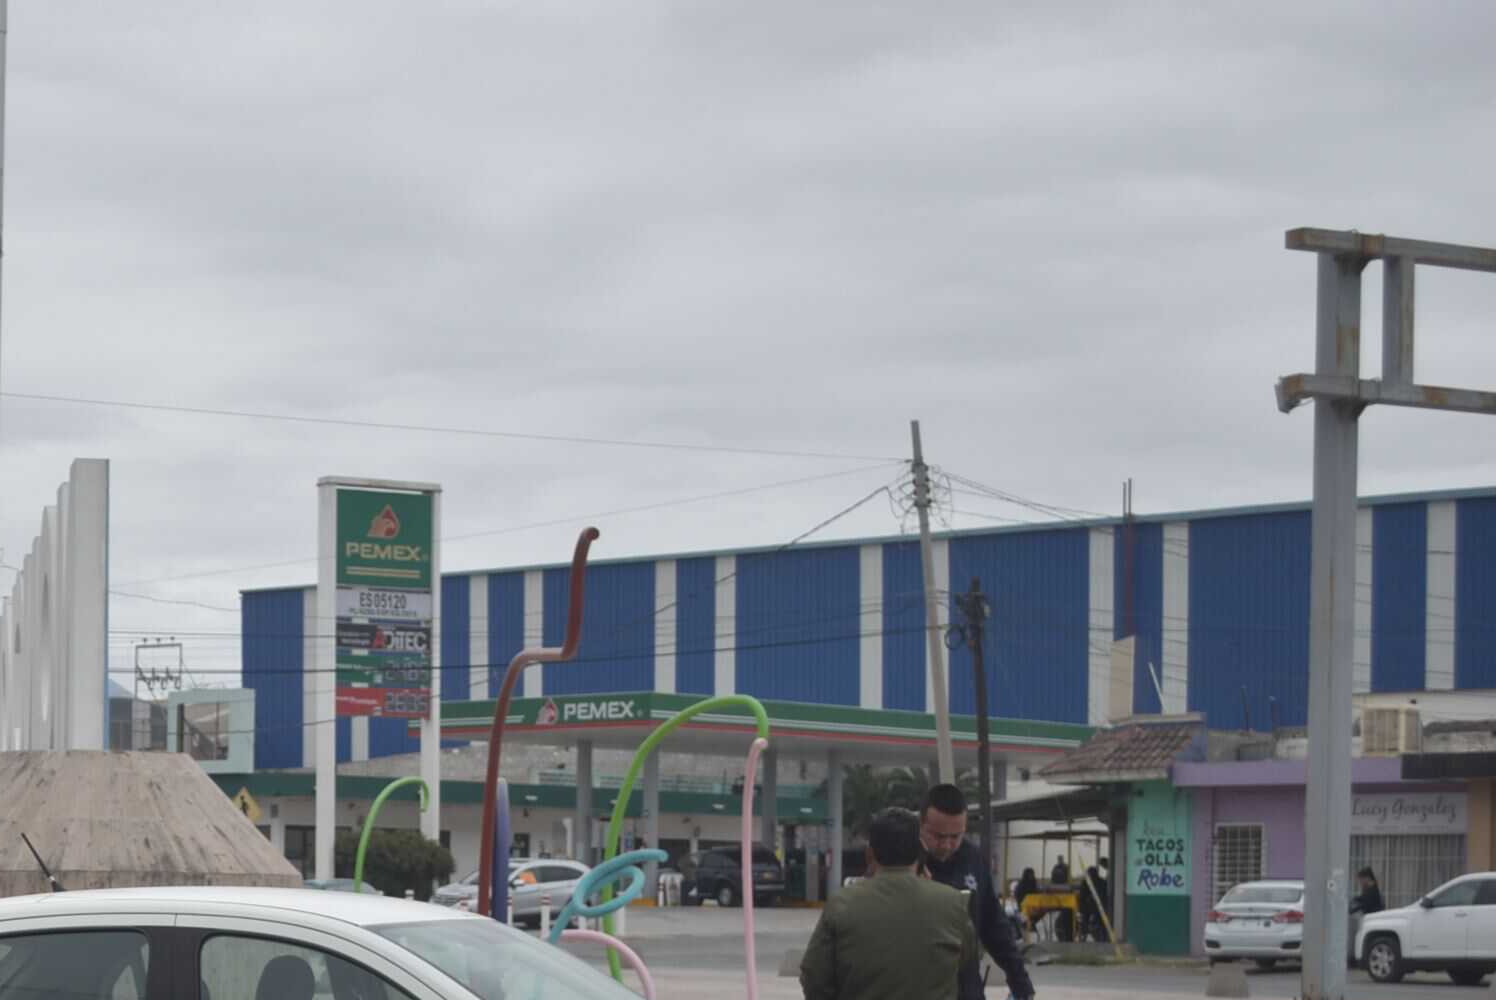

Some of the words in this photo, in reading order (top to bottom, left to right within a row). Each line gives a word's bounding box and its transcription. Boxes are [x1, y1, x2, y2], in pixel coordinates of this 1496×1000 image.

[345, 541, 421, 561] PEMEX
[563, 701, 635, 721] PEMEX
[1135, 838, 1185, 853] TACOS
[1144, 853, 1185, 867] OLLA
[1136, 867, 1185, 891] Robe
